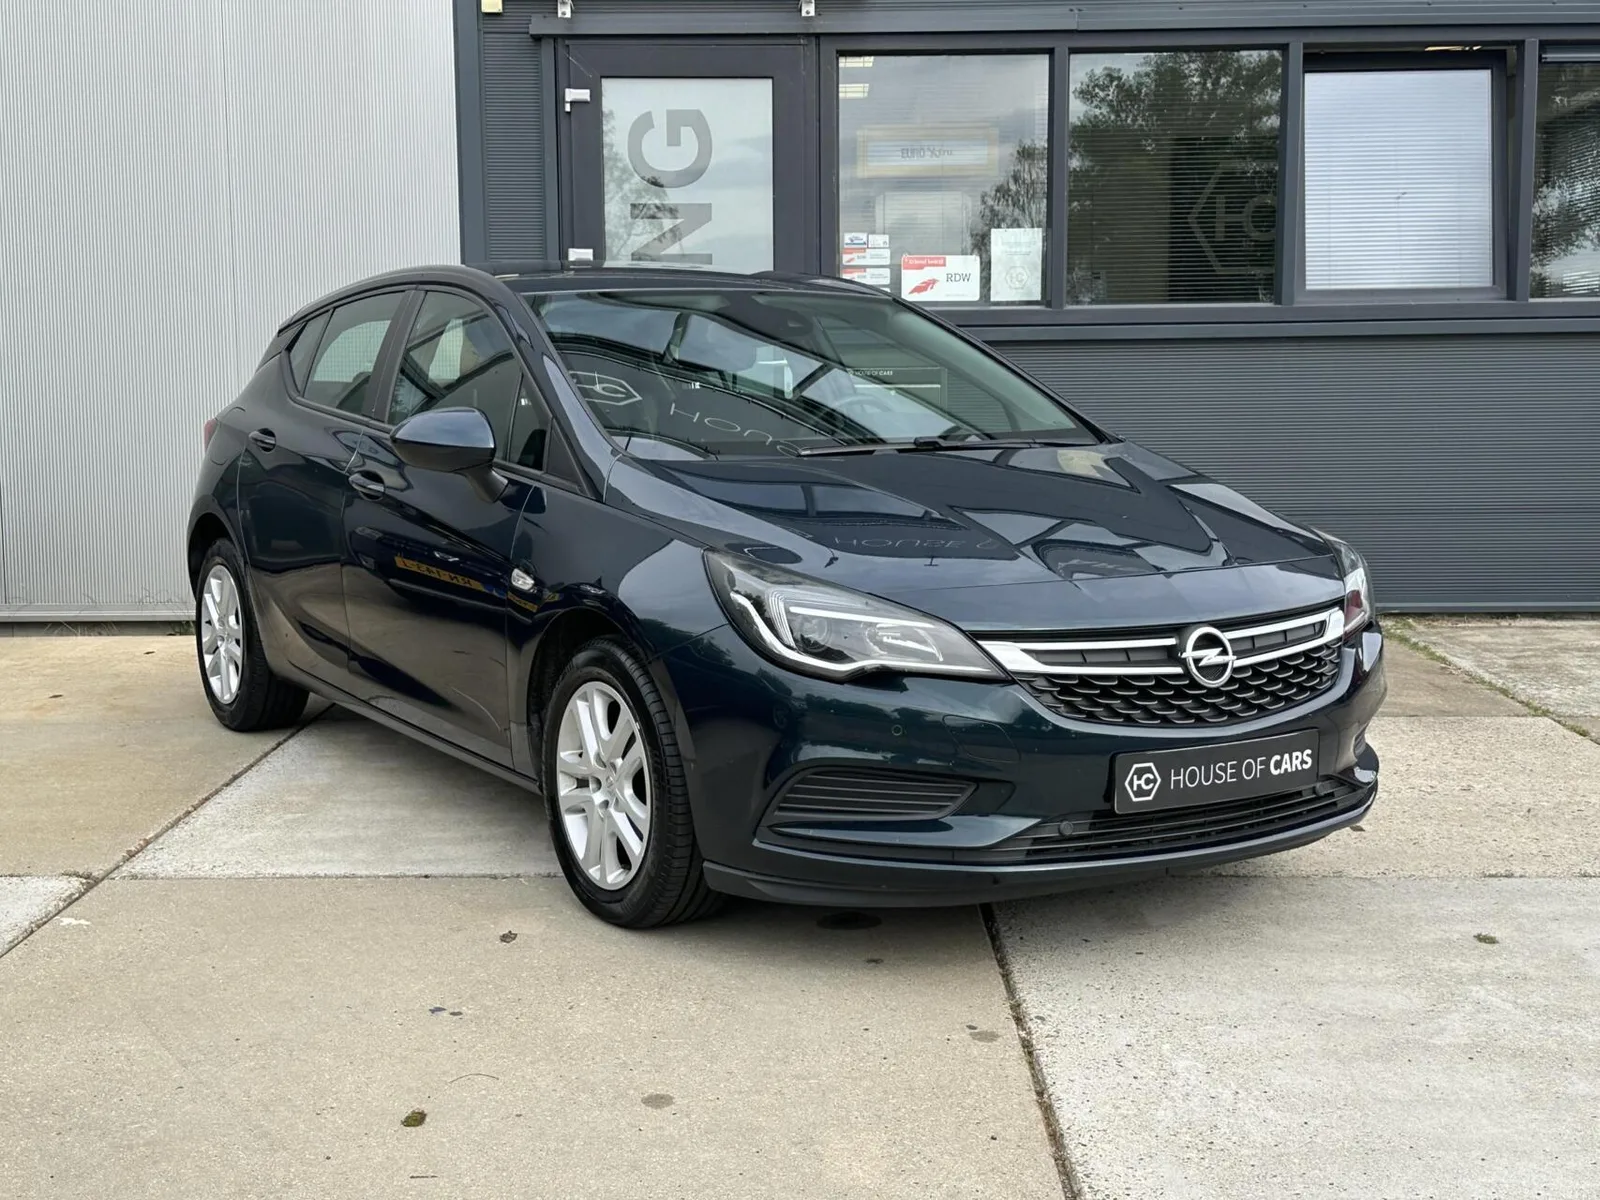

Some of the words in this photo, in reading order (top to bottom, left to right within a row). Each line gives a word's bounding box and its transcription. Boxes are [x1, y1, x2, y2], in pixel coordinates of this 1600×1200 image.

[945, 273, 972, 283] RDW
[1170, 760, 1237, 790] HOUSE
[1242, 757, 1267, 780] OF
[1269, 748, 1312, 775] CARS
